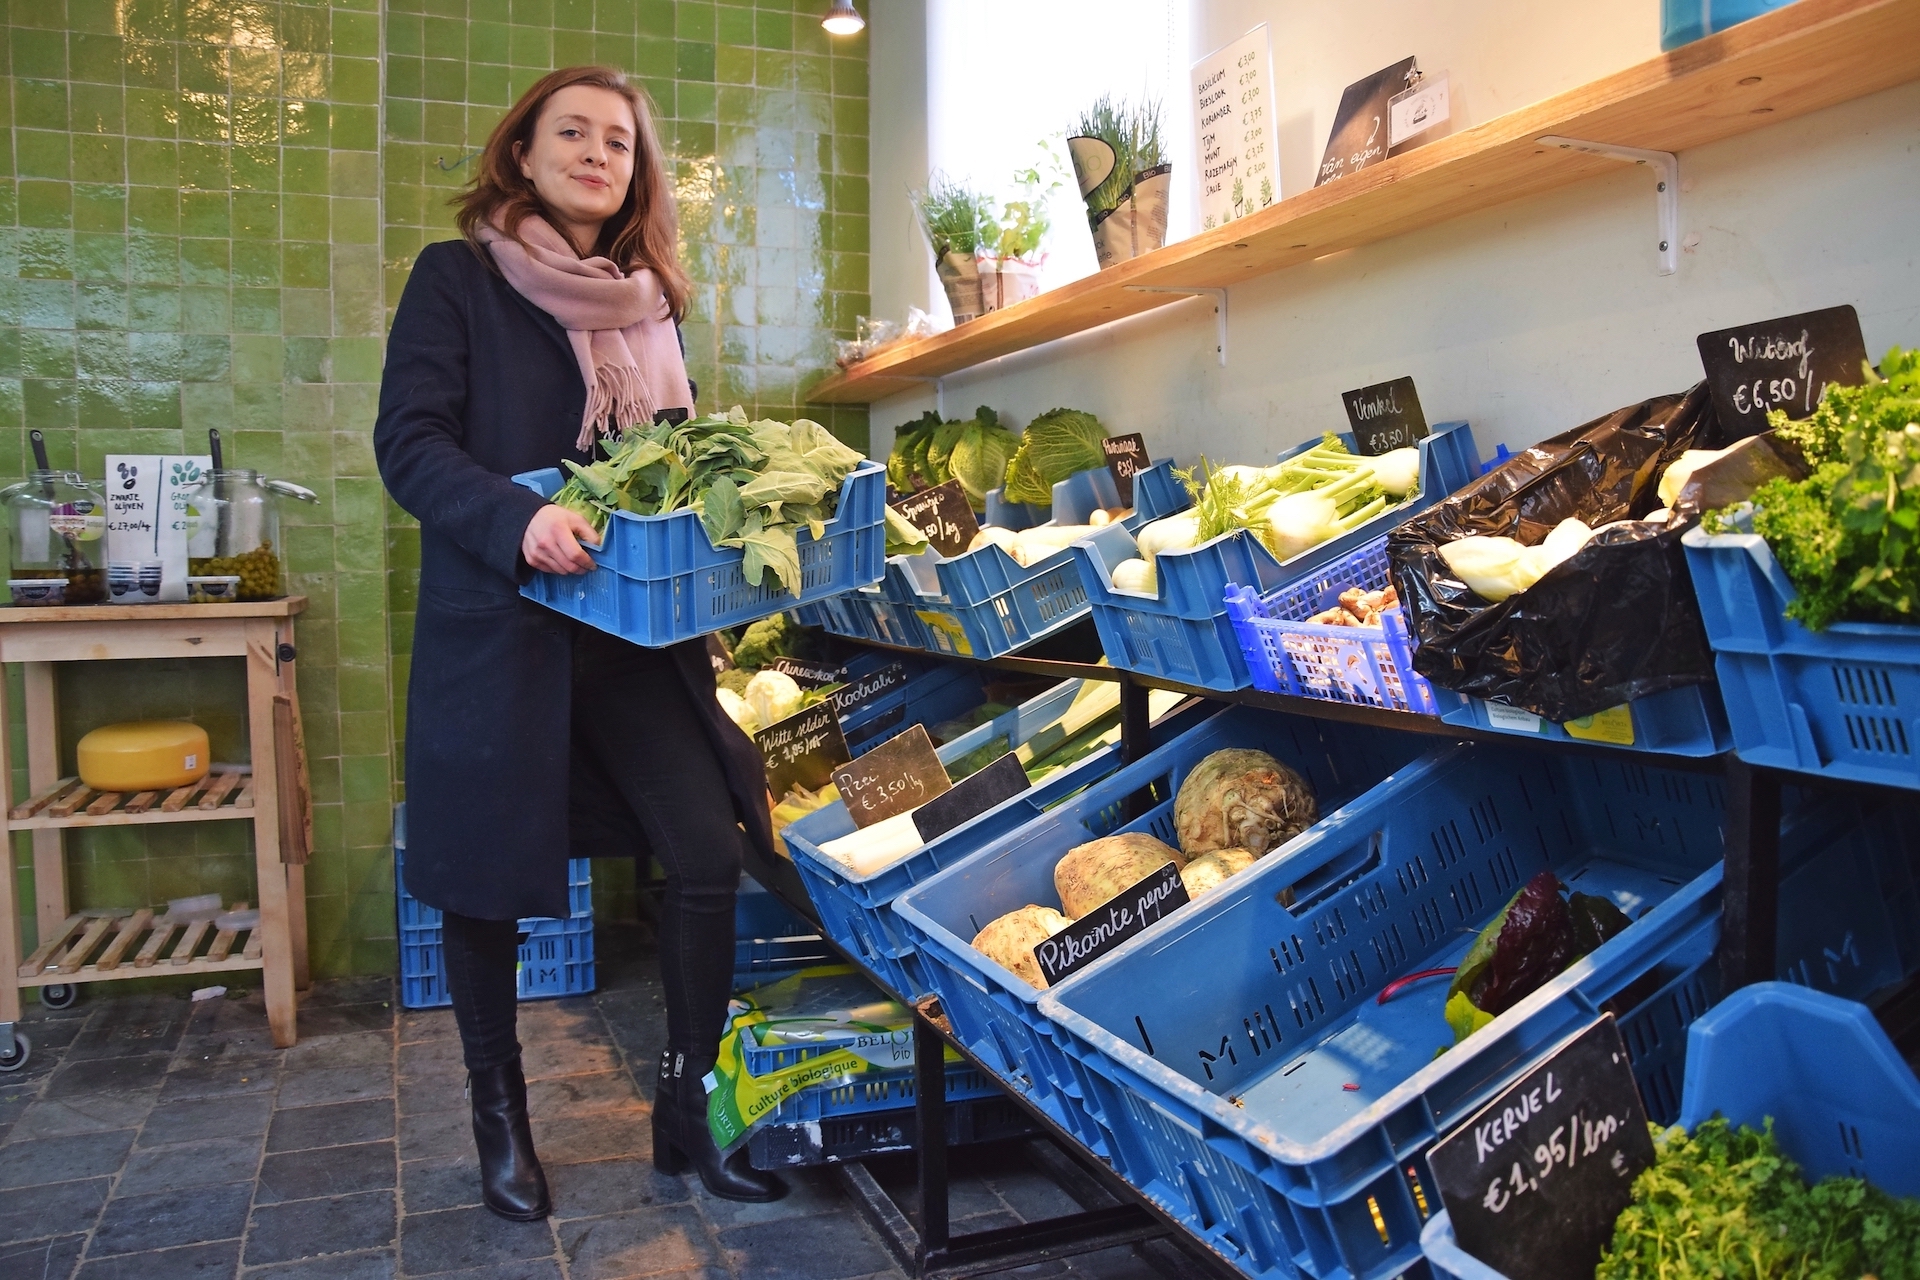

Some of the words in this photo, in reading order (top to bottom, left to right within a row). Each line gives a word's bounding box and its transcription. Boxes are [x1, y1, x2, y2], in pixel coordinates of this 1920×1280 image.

[1350, 145, 1383, 172] eigen
[1352, 386, 1403, 421] Venkel
[110, 493, 140, 502] ZWARTE
[833, 674, 896, 711] Koolrabi
[758, 729, 793, 753] Witte
[839, 768, 880, 798] Prei
[1039, 907, 1133, 976] Pikante
[1136, 874, 1182, 928] peper
[891, 1043, 911, 1061] bio
[748, 1083, 790, 1117] Culture
[790, 1060, 858, 1088] biologique
[1474, 1072, 1562, 1164] KERVEL
